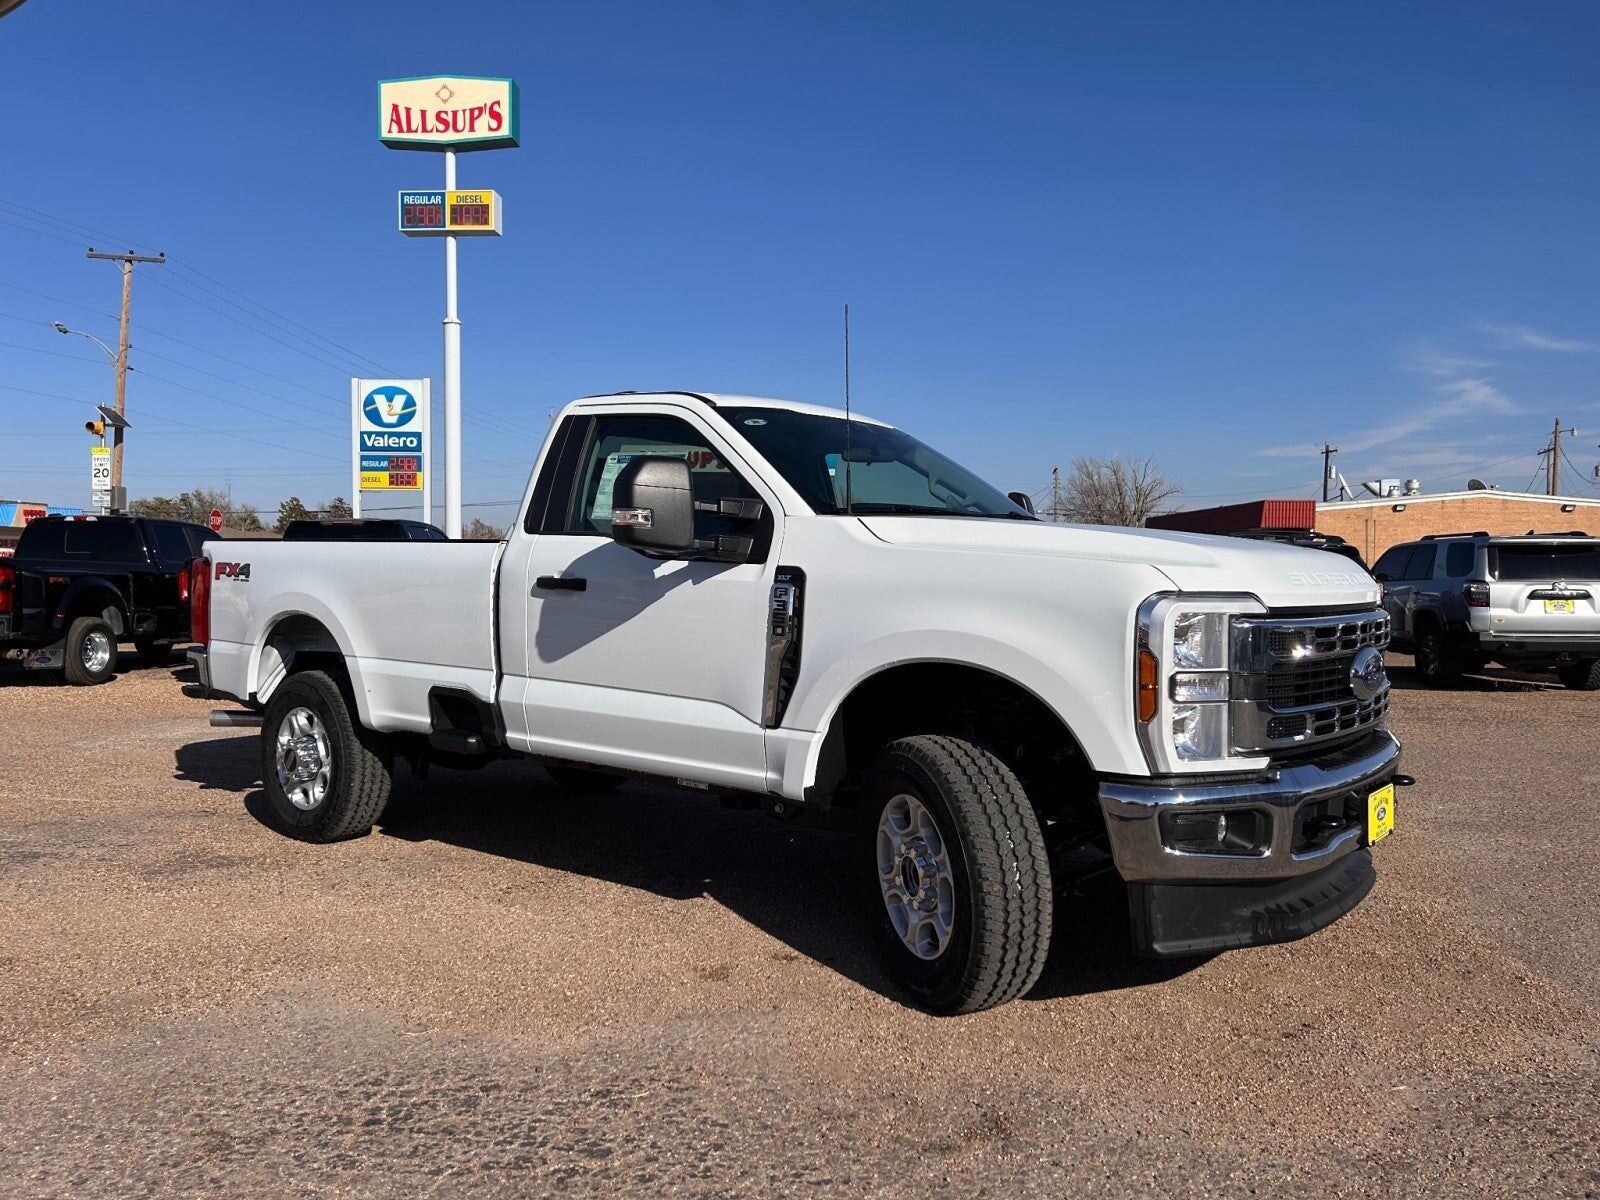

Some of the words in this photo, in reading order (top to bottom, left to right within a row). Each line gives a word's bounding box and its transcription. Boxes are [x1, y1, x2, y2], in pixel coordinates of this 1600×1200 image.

[387, 100, 503, 133] ALLSUP'S
[404, 195, 442, 205] REGULAR
[456, 195, 484, 204] DIESEL
[362, 434, 418, 448] Valero
[361, 460, 389, 468] REGULAR
[93, 468, 110, 478] 20
[210, 516, 222, 526] STOP
[214, 561, 251, 581] FX4
